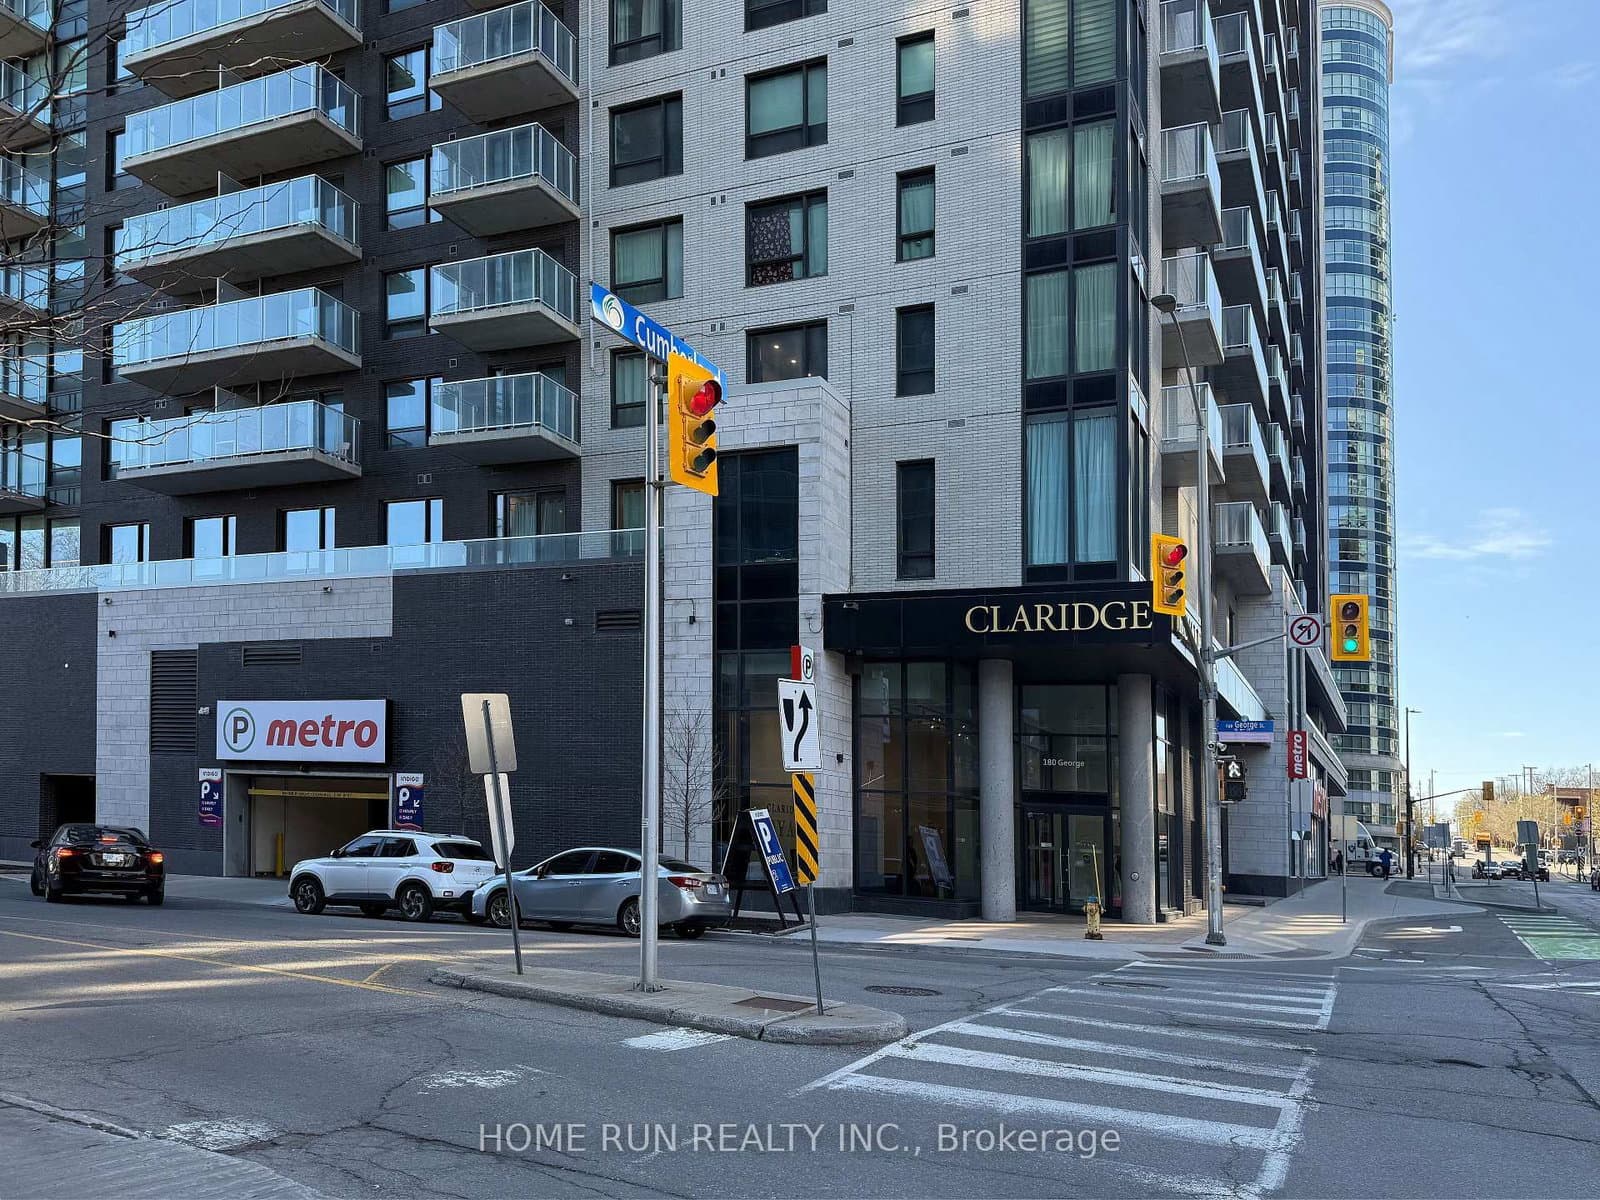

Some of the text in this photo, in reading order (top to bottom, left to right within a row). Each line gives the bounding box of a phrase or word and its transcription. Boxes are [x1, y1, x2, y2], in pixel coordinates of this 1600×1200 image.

[965, 601, 1153, 633] CLARIDGE
[233, 715, 378, 748] P metro
[1234, 720, 1258, 730] George
[1043, 758, 1085, 769] 180 George
[1294, 734, 1303, 775] metro
[201, 781, 211, 799] P
[399, 787, 410, 807] P
[758, 821, 772, 853] P
